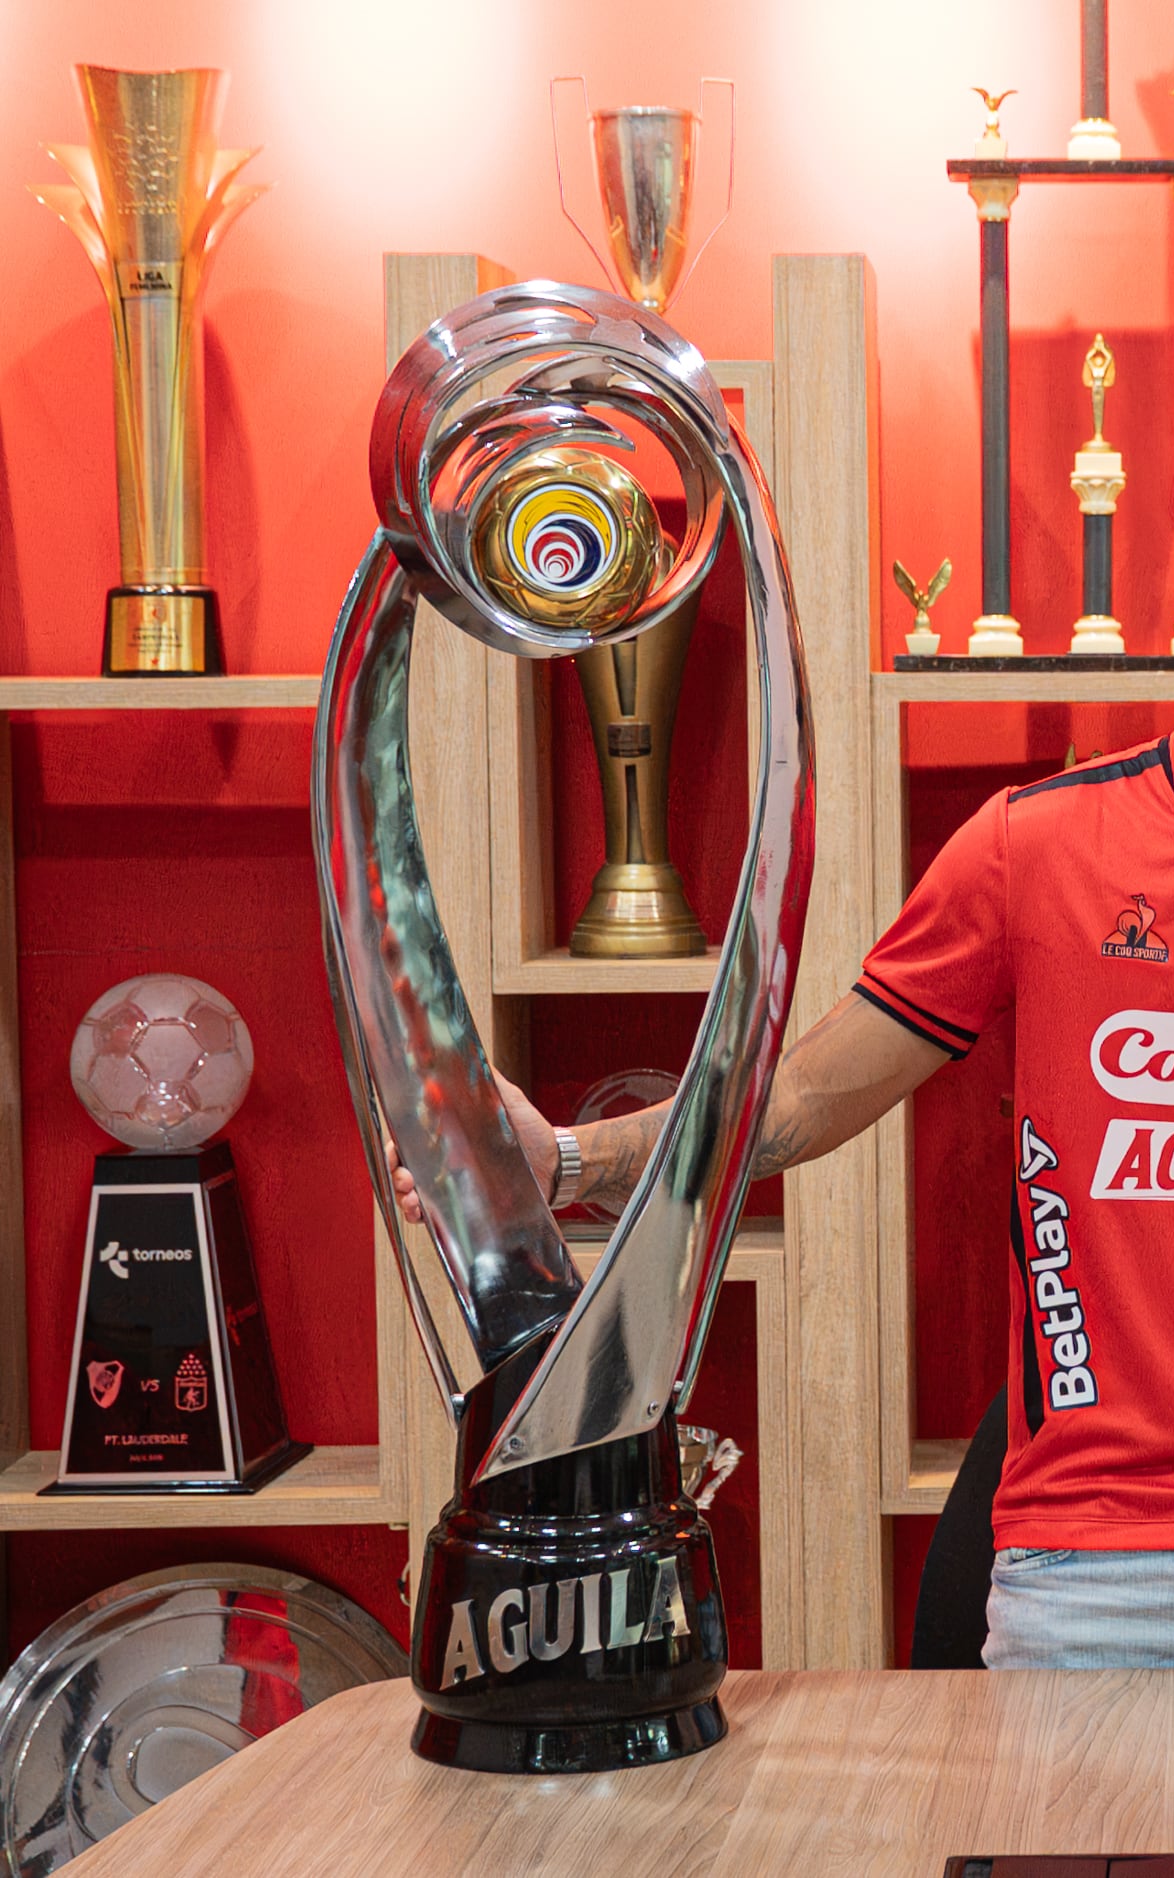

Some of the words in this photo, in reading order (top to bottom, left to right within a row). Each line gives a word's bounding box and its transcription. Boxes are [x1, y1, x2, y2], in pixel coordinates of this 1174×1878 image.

[137, 271, 163, 281] LIGA
[1102, 944, 1114, 957] LE
[1115, 945, 1132, 958] COQ
[1133, 947, 1168, 961] SPORTIF
[132, 1247, 193, 1262] torneos
[1030, 1186, 1098, 1411] BetPlay
[438, 1555, 692, 1692] AGUILA
